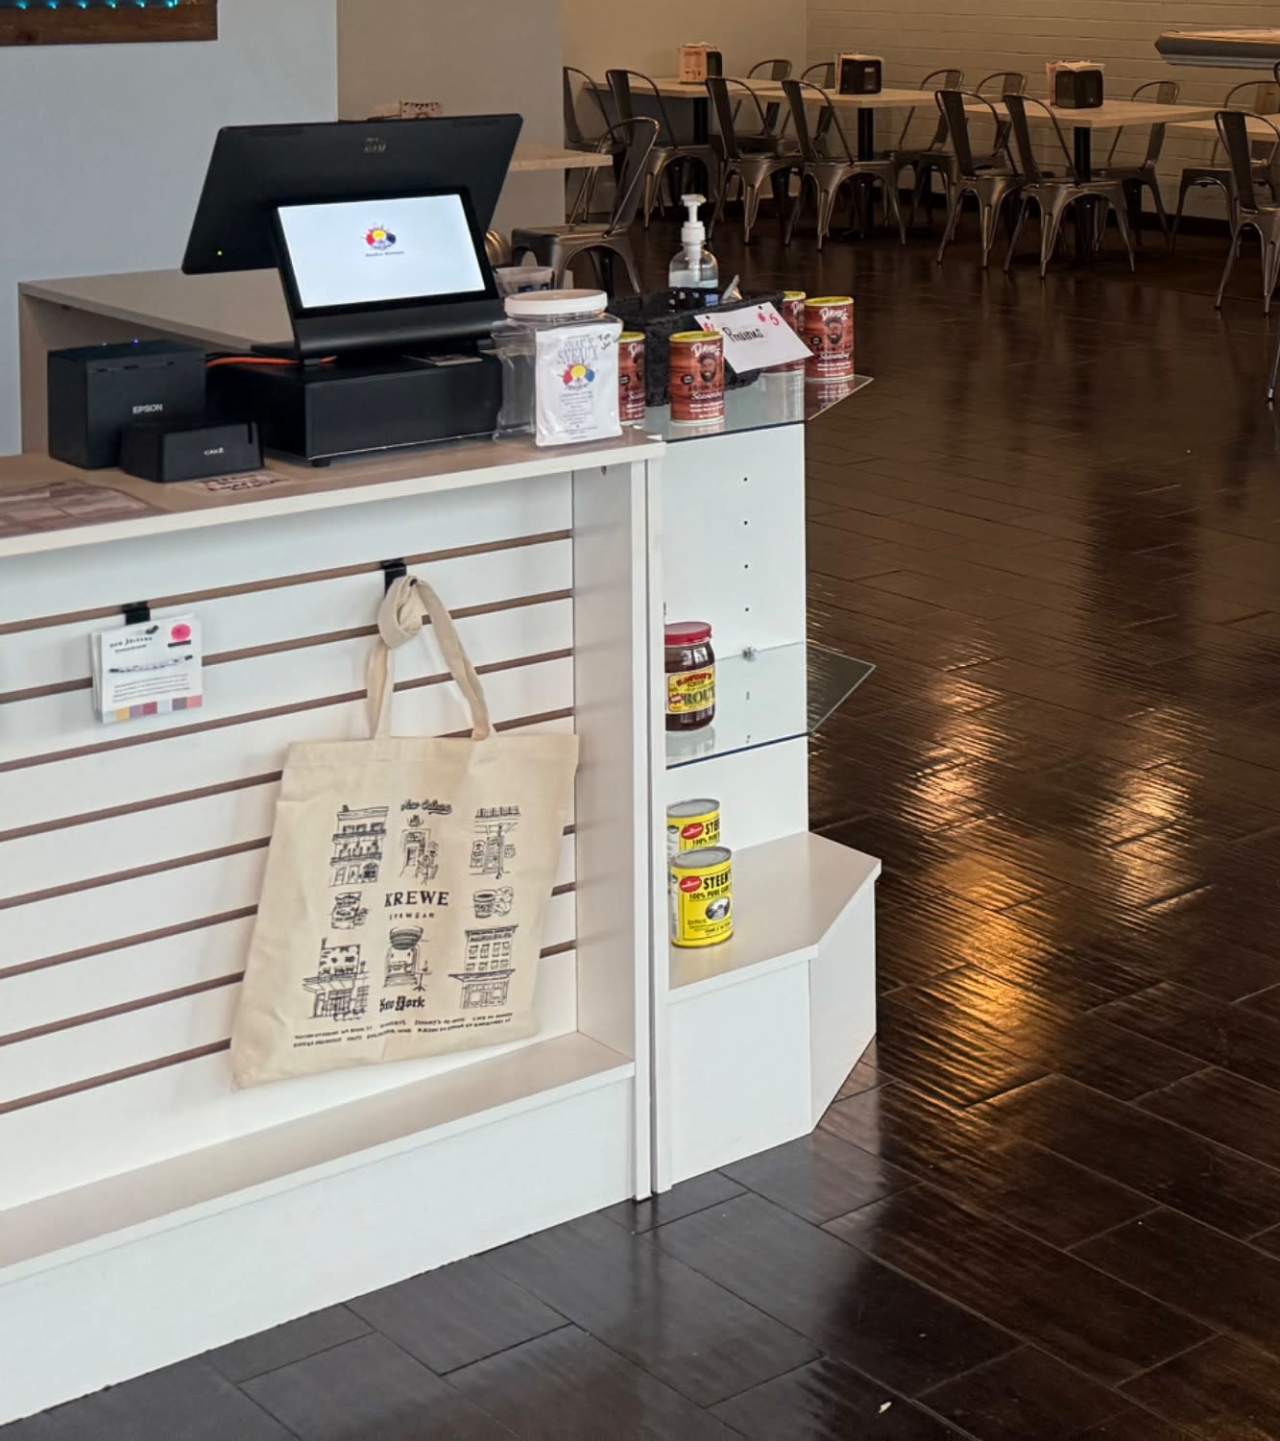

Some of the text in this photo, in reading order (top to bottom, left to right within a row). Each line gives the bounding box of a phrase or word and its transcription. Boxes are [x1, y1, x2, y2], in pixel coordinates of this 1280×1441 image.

[132, 404, 163, 414] EPSON
[703, 873, 730, 890] STEEN
[384, 890, 450, 908] KREWE
